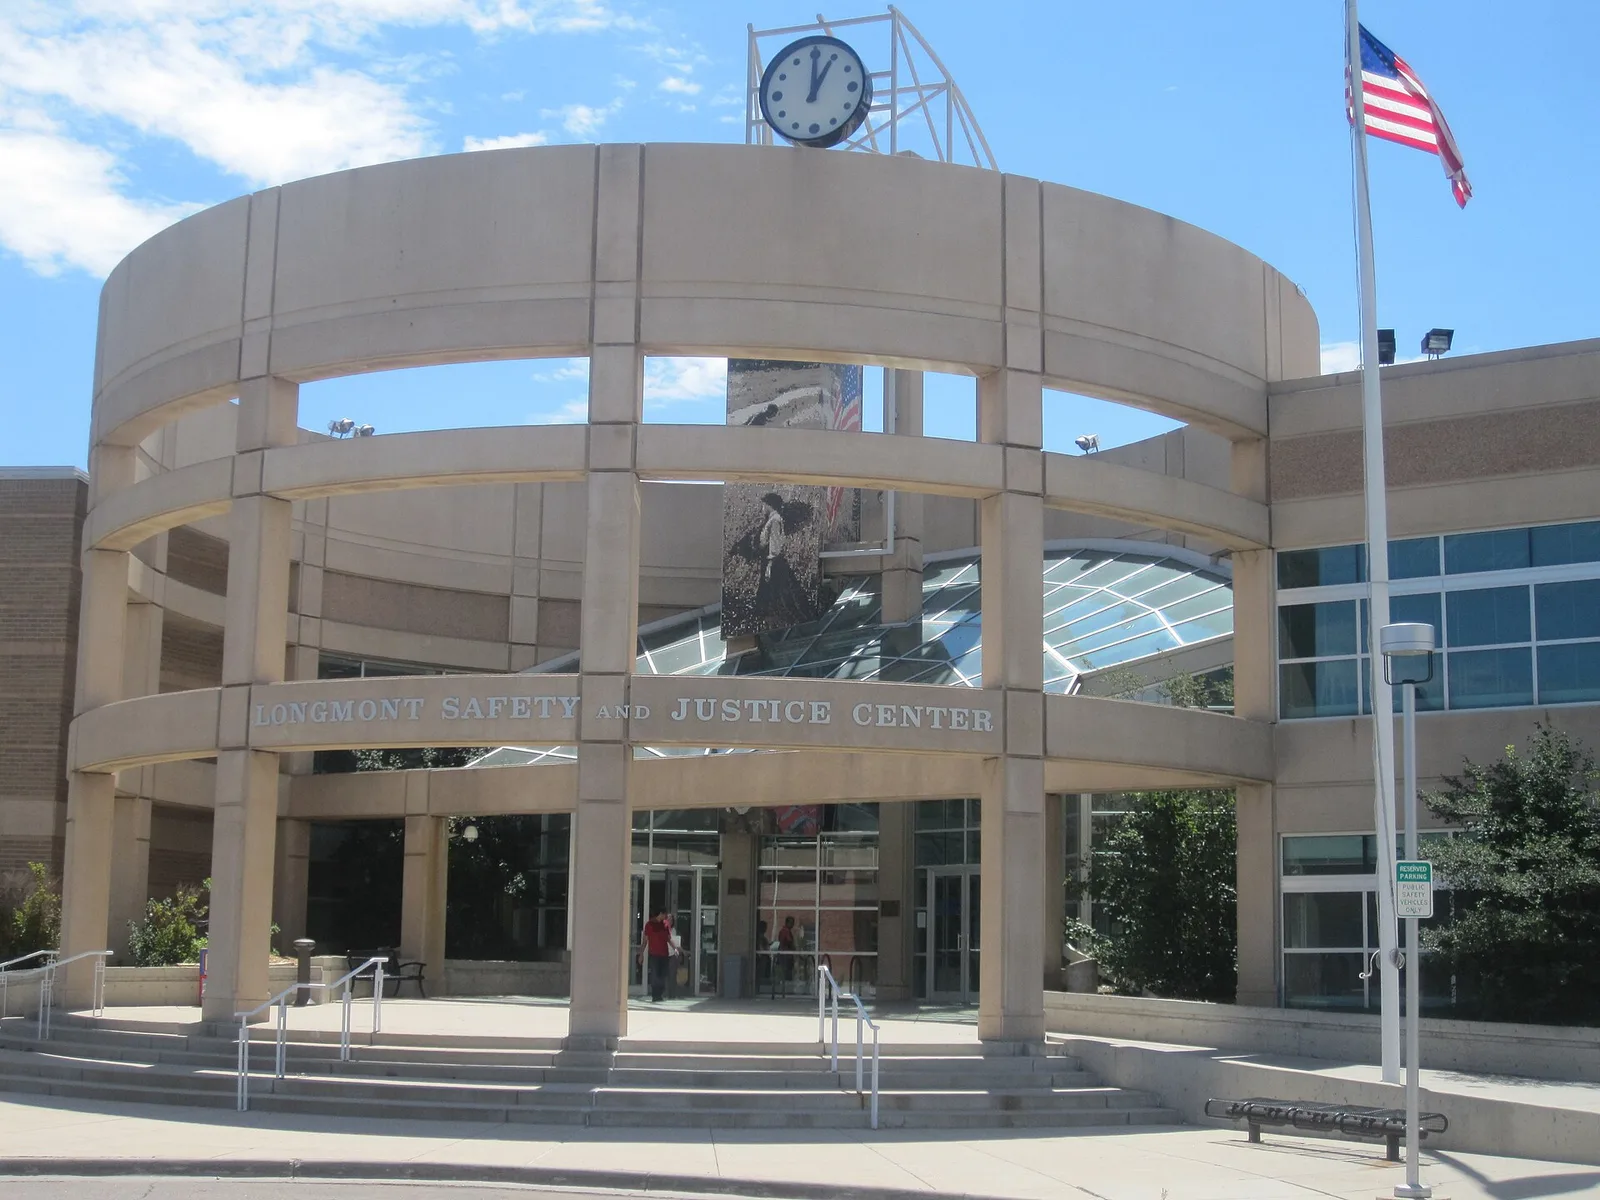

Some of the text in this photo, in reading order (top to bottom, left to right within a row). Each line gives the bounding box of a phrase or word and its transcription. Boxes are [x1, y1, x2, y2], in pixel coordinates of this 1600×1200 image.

[254, 696, 994, 732] LONGMONT SAFETY AND JUSTICE CENTER
